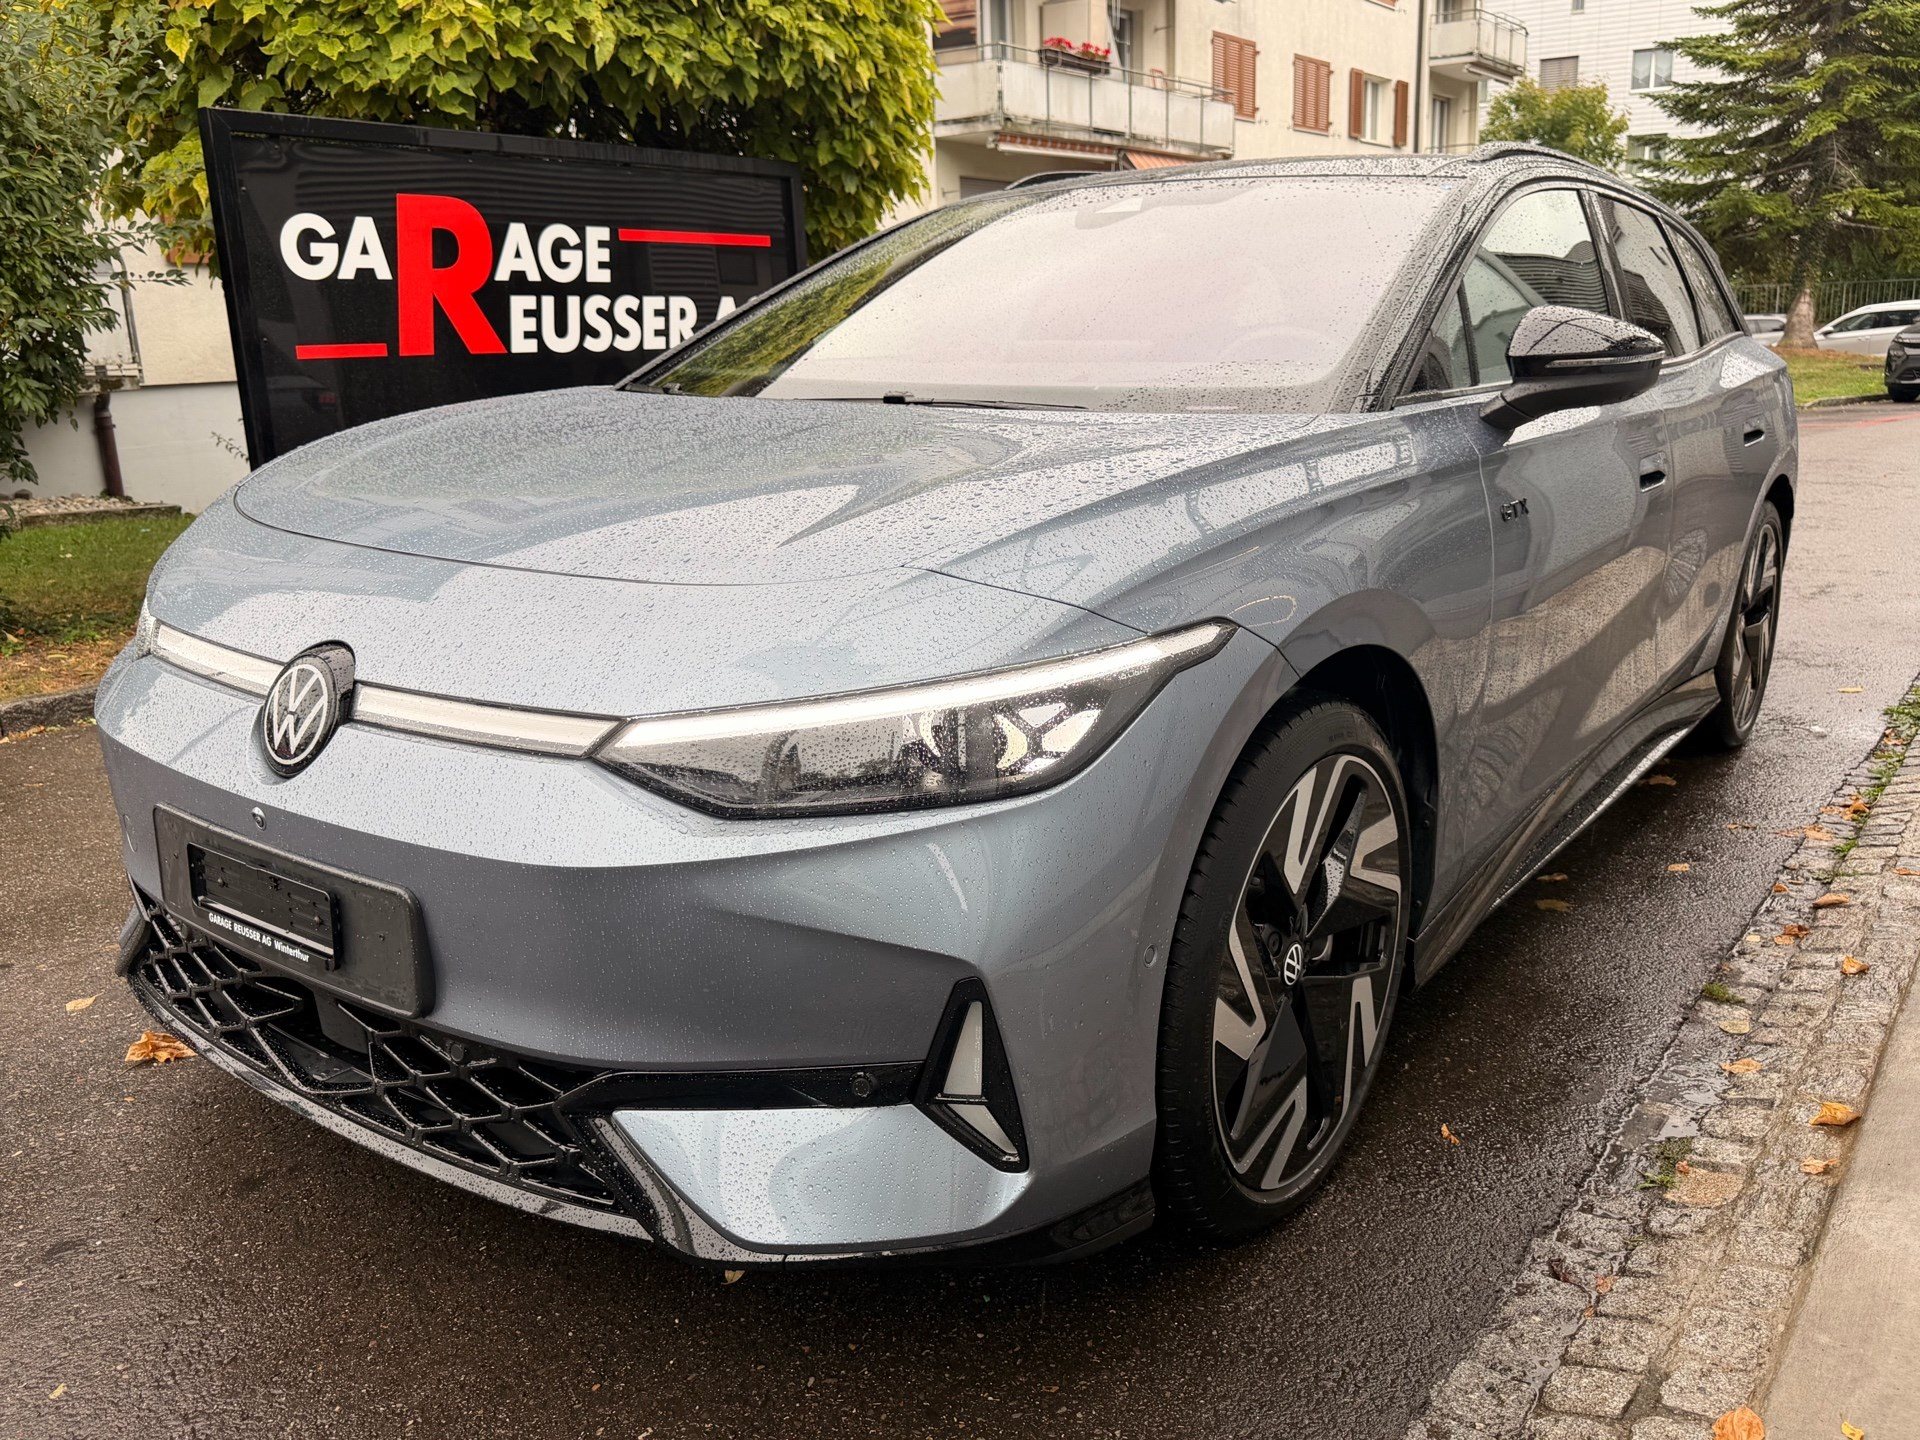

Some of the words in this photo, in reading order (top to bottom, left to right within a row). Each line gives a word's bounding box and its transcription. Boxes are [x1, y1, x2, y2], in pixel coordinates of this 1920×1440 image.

[279, 193, 611, 356] GARAGE
[1501, 498, 1529, 522] GTX
[208, 912, 233, 931] GARAGE
[233, 922, 261, 943] REUSSER
[261, 934, 272, 947] AG
[274, 939, 310, 963] Winterthur
